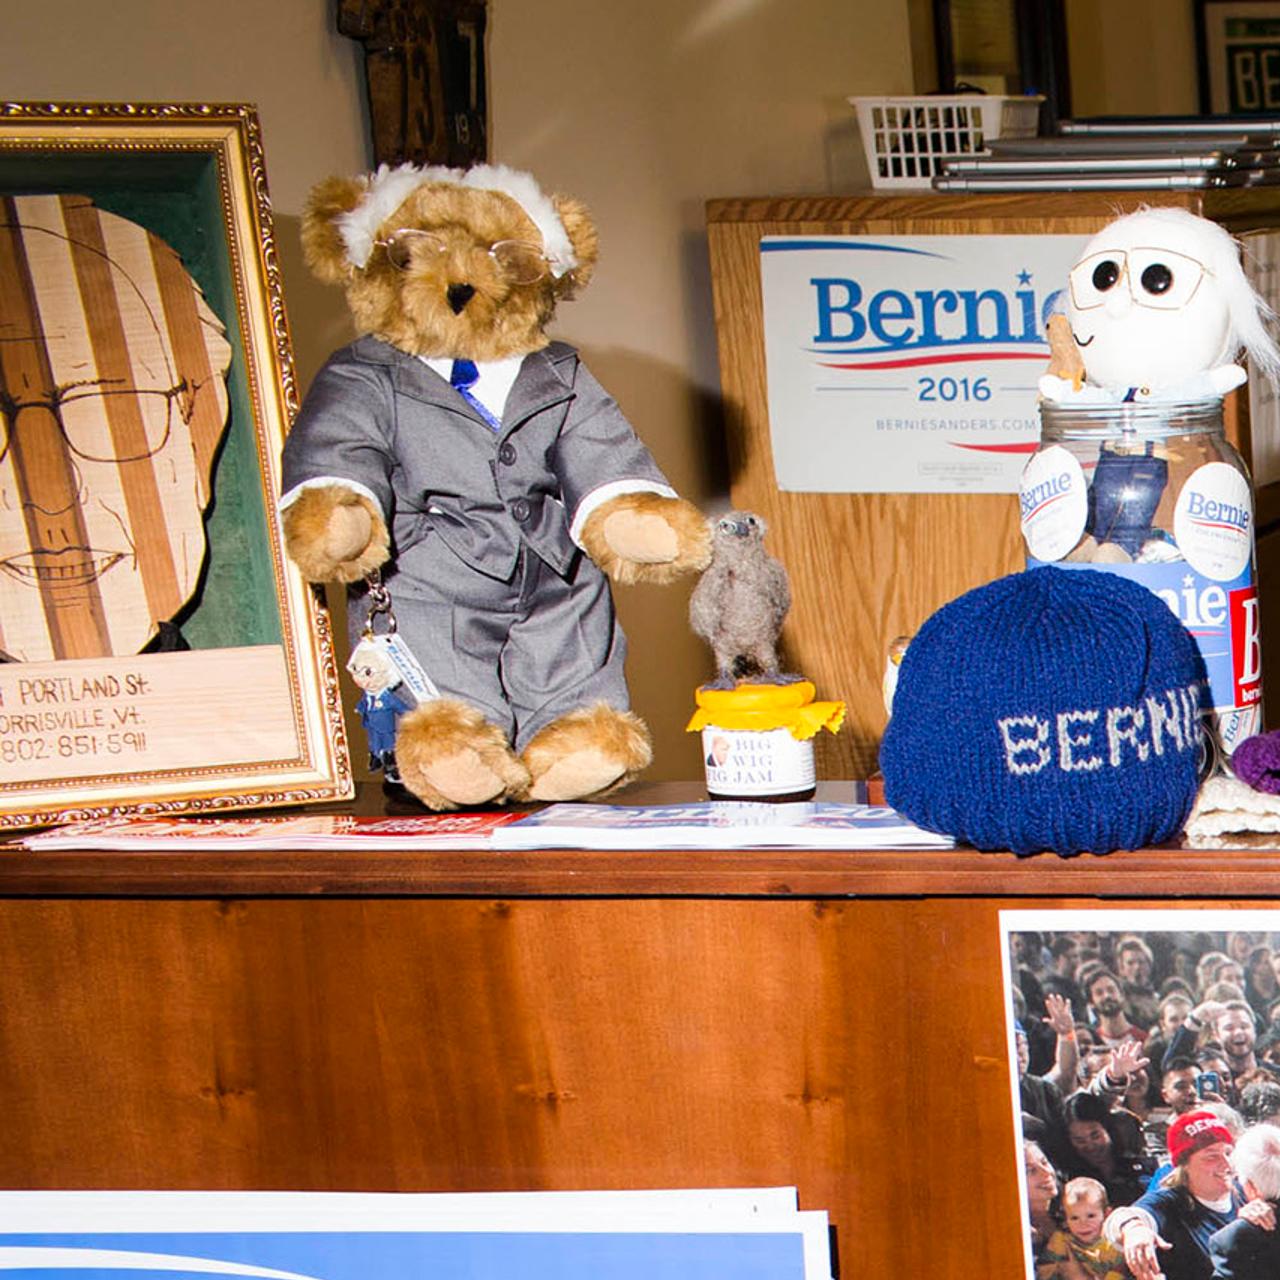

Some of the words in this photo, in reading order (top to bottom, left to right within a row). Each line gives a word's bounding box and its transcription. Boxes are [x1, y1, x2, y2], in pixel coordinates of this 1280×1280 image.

[918, 378, 992, 402] 2016
[876, 418, 1037, 432] BERNIESANDERS.COM
[1186, 491, 1250, 531] Bernie
[1155, 574, 1228, 626] nie
[18, 675, 121, 706] PORTLAND
[736, 739, 772, 751] BIG
[733, 755, 773, 767] WIG
[734, 769, 773, 783] JAM
